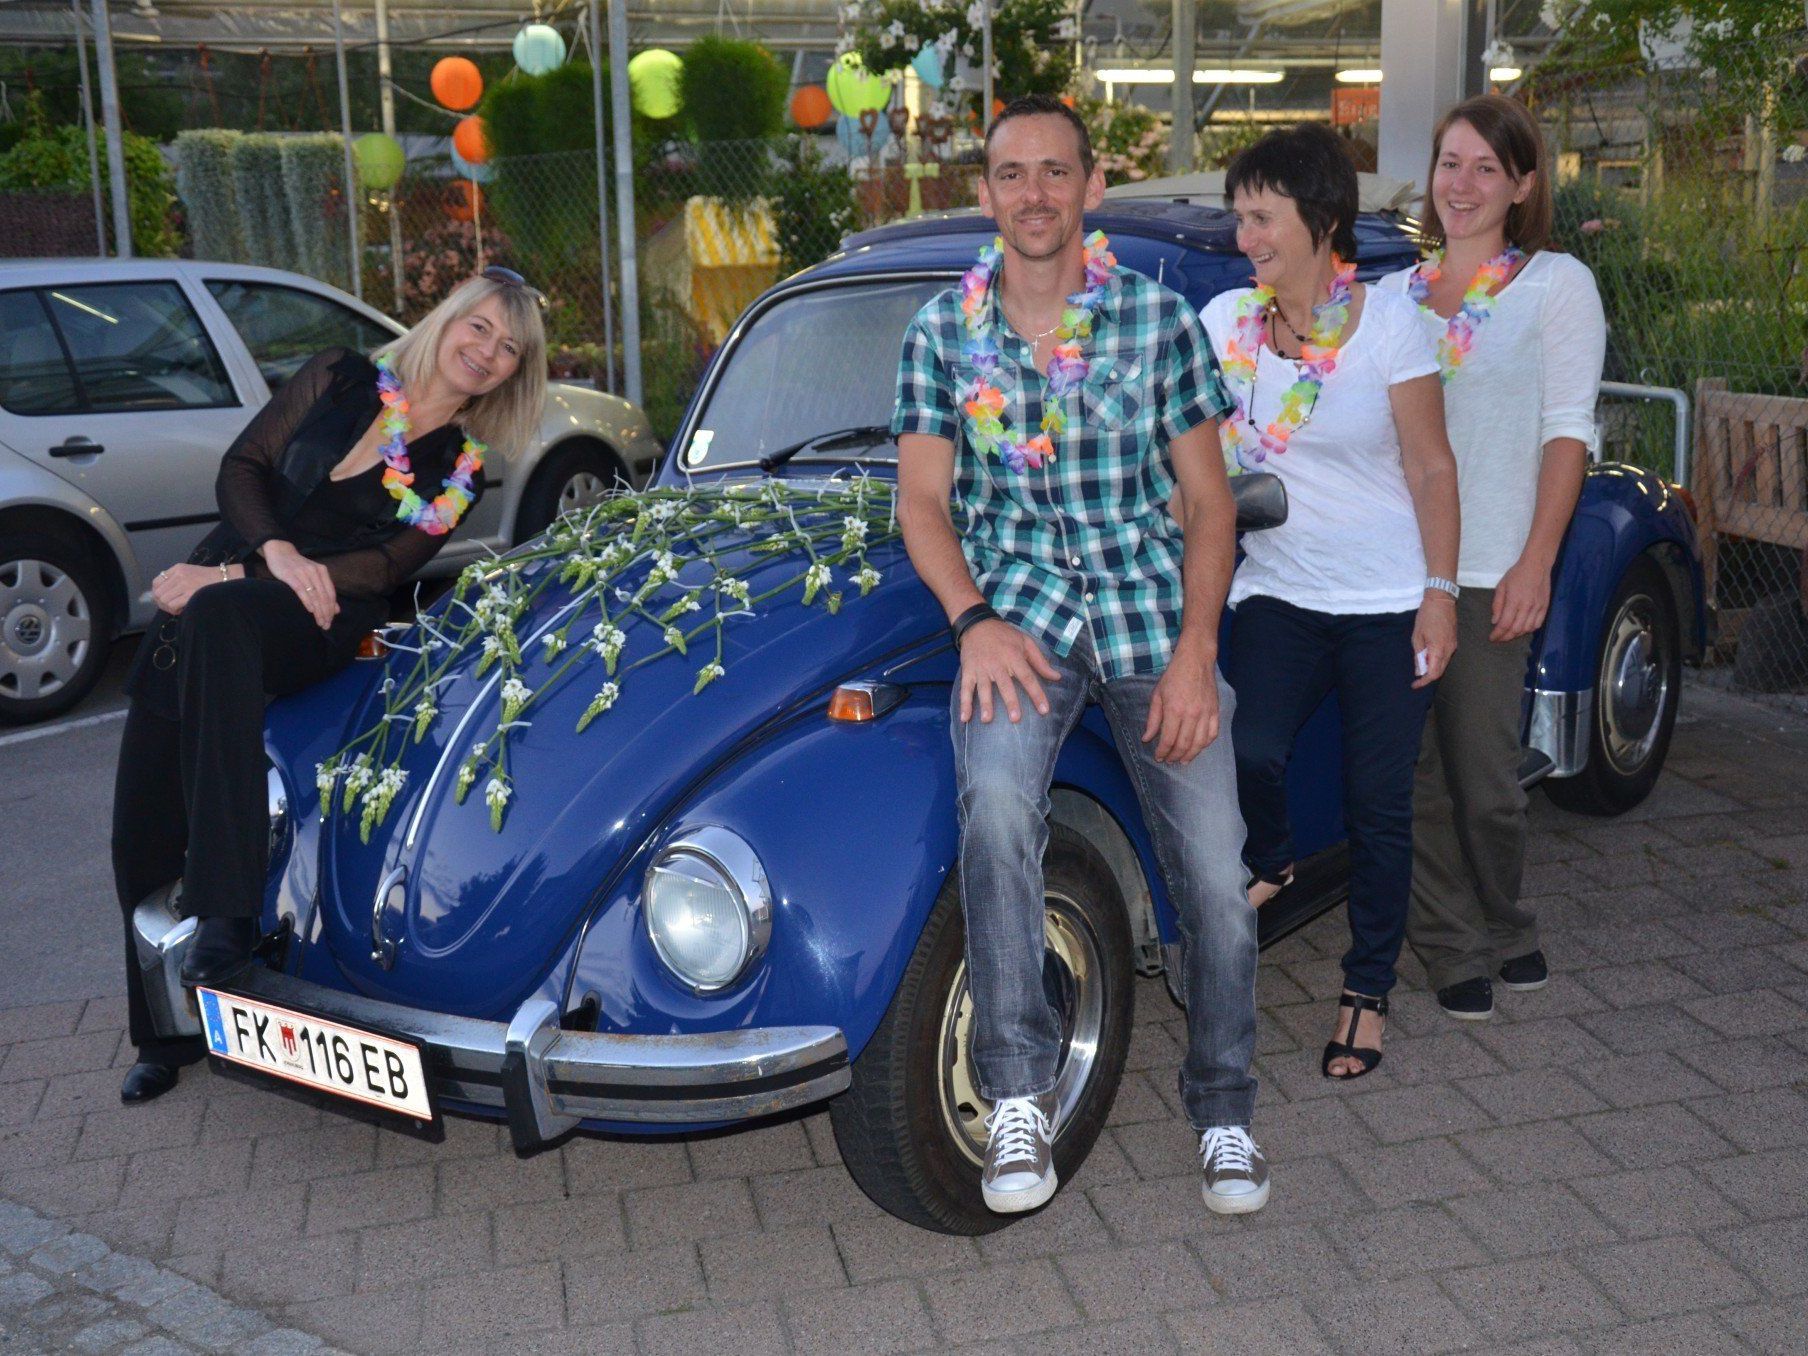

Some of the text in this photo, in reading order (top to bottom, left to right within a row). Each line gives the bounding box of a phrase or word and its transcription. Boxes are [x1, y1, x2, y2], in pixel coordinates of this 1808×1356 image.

[214, 1030, 223, 1044] A
[232, 1007, 409, 1099] FK 116 EB
